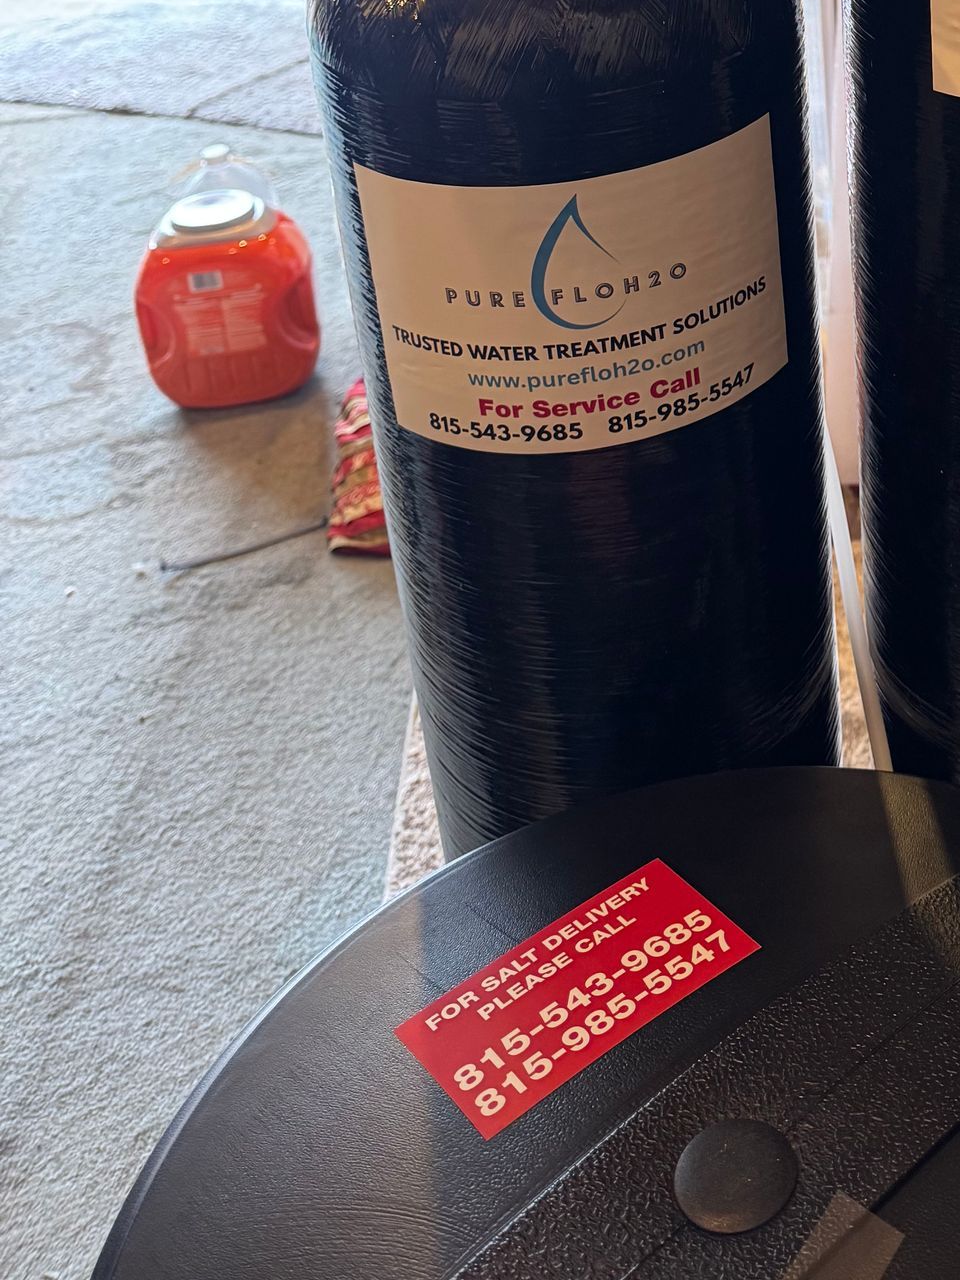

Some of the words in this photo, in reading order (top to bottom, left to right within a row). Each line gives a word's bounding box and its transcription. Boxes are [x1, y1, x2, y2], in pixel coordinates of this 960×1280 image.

[392, 324, 463, 358] TRUSTED
[467, 342, 537, 362] WATER
[543, 323, 667, 360] TREATMENT
[672, 275, 767, 335] SOLUTIONS
[445, 287, 526, 308] PURE
[551, 262, 687, 306] FLOH2O
[429, 412, 583, 442] 815-543-9685
[608, 362, 755, 434] 815-985-5547
[468, 340, 705, 392] www.purefloh2o.com
[478, 397, 523, 419] For
[532, 390, 640, 418] Service
[649, 367, 701, 399] Call
[425, 991, 479, 1032] FOR
[481, 949, 538, 993] SALT
[541, 877, 651, 952] DELIVERY
[477, 952, 573, 1021] PLEASE
[574, 913, 637, 954] CALL
[454, 910, 712, 1091] 815-543-9685
[474, 929, 731, 1117] 815-985-5547
